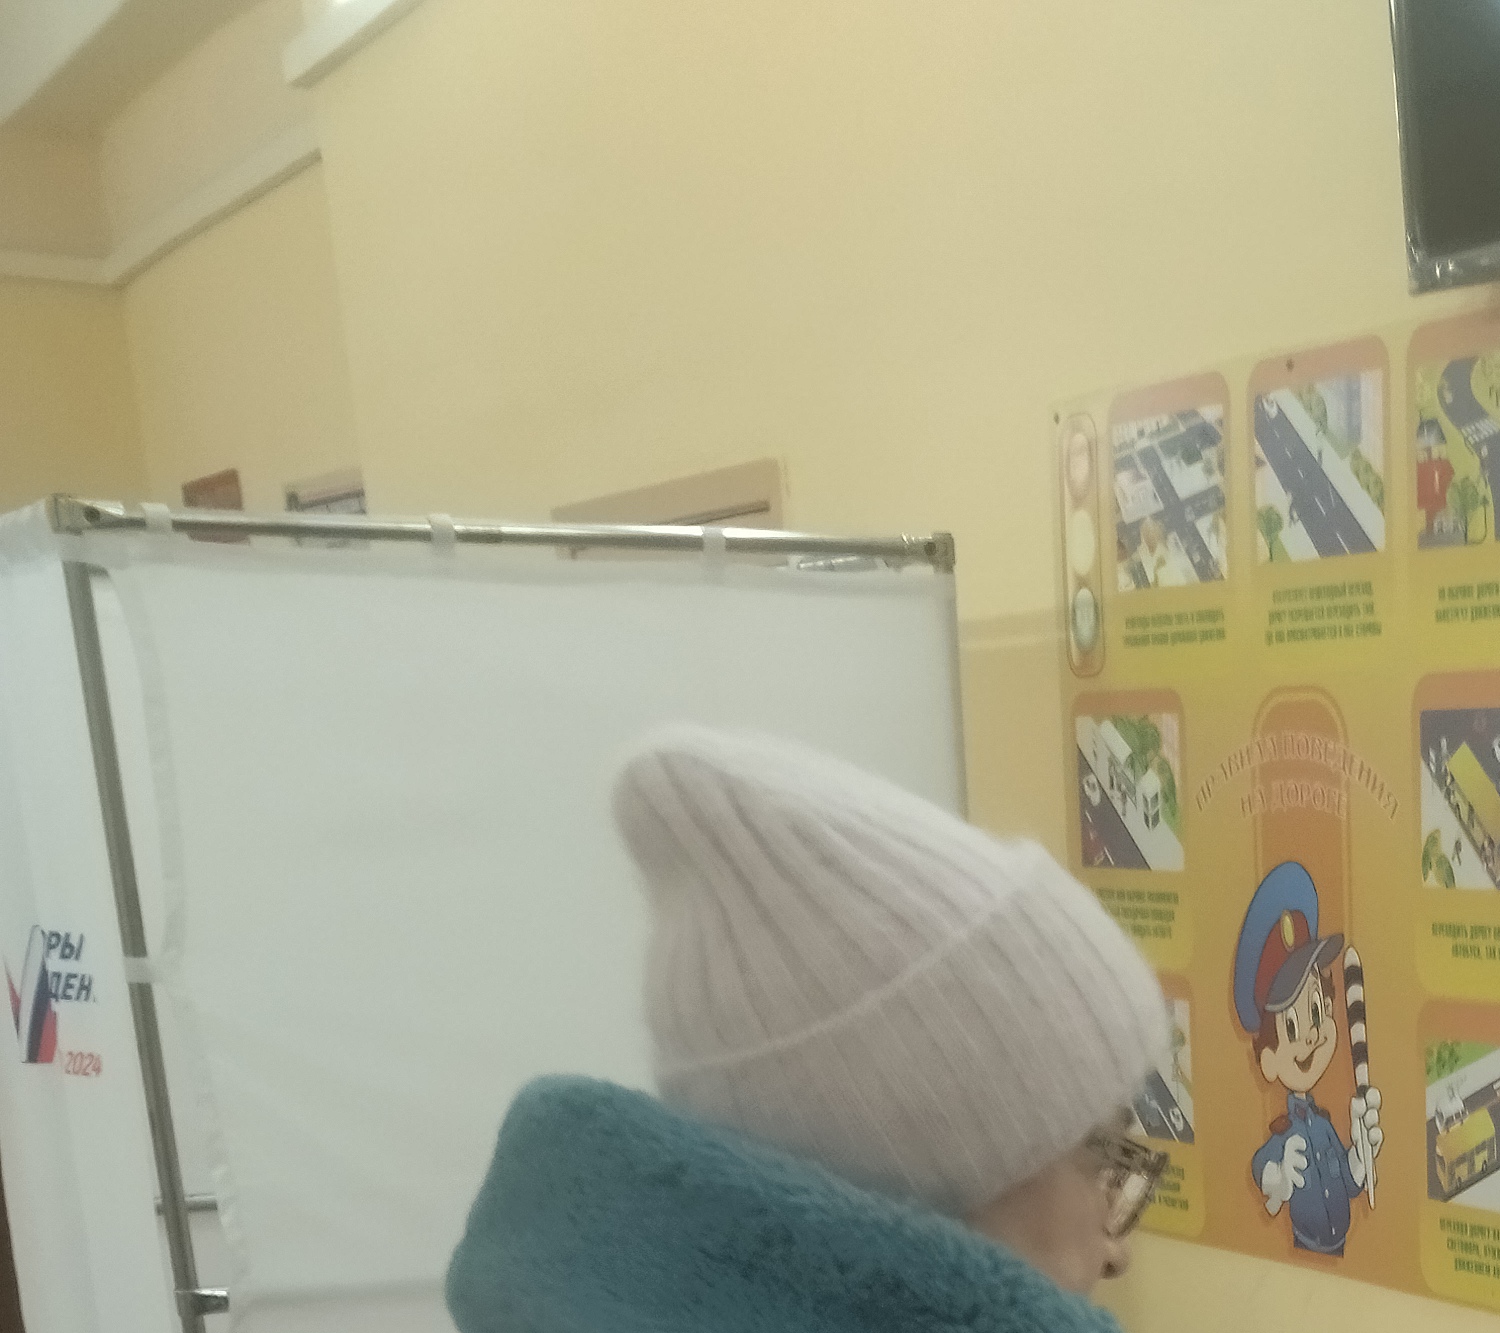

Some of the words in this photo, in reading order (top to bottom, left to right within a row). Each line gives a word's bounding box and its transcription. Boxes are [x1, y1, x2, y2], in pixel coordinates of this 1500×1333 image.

[42, 929, 84, 961] РЫ
[48, 971, 97, 1003] ДЕН
[64, 1050, 103, 1077] 2024
